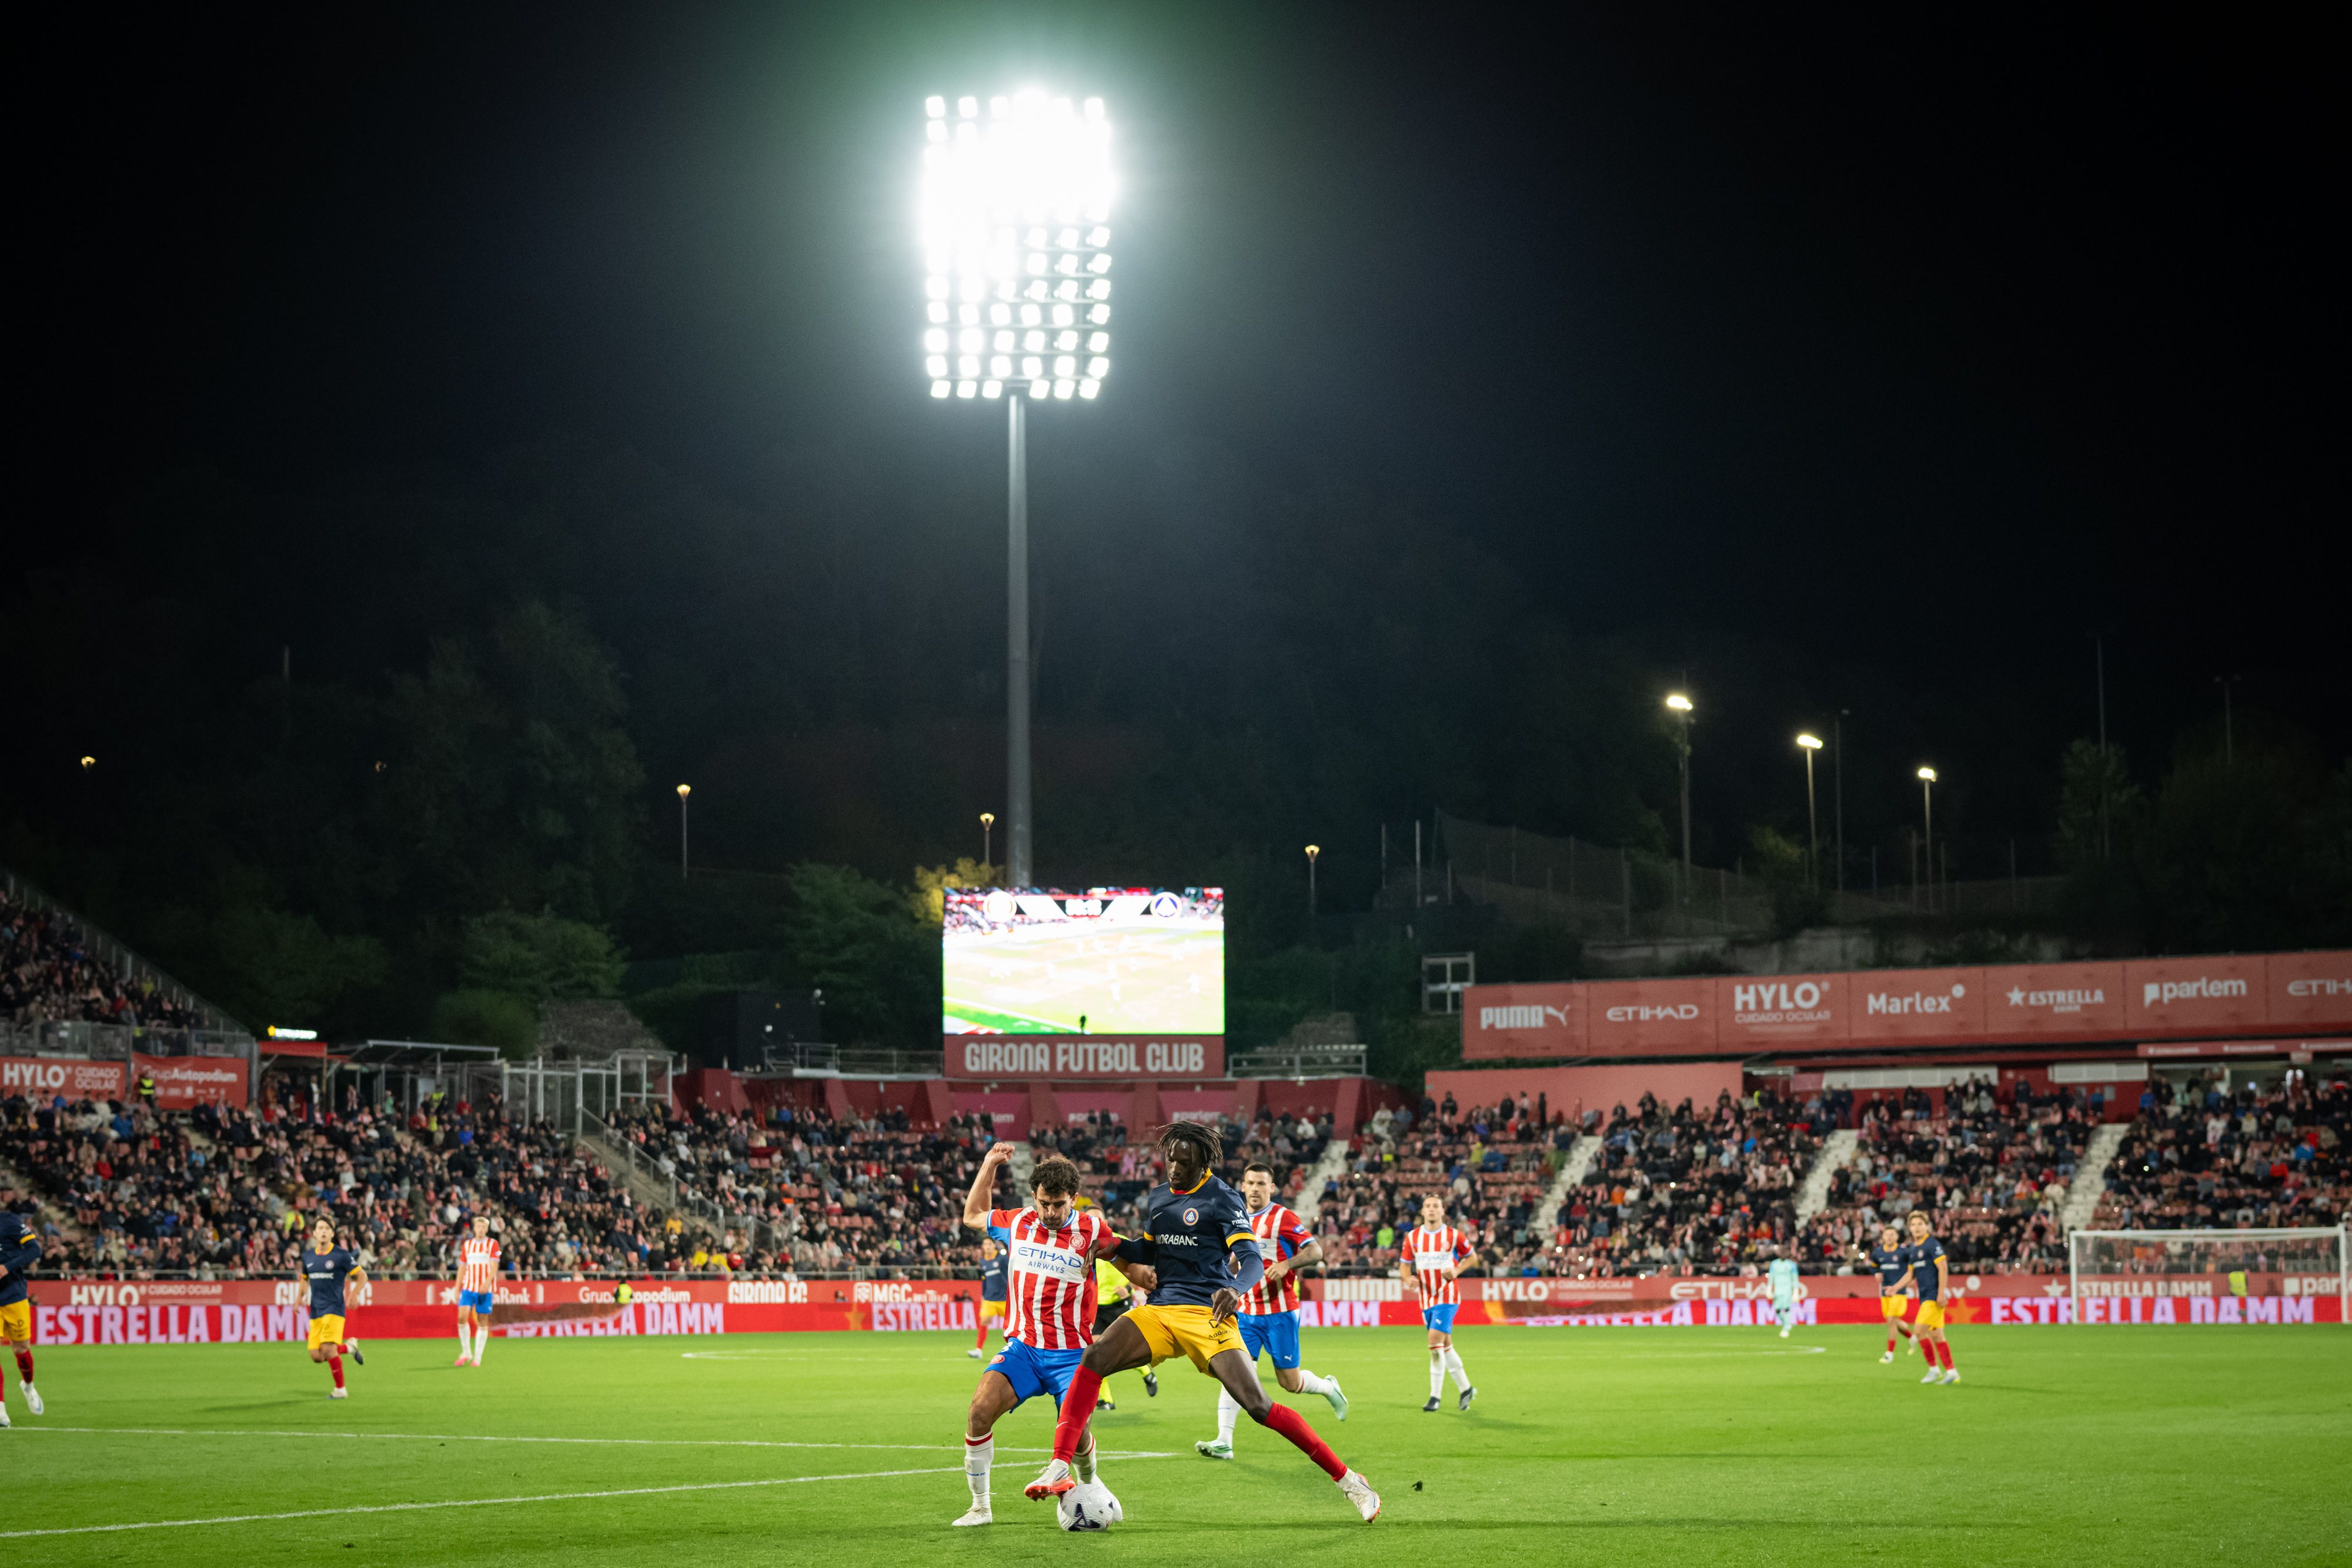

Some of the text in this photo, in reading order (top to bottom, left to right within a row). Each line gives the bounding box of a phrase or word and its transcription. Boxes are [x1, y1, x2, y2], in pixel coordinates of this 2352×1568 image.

[1735, 982, 1820, 1011] HYLO
[2029, 989, 2104, 1007] ESTRELLA
[2163, 978, 2247, 1004] parlem
[2287, 979, 2352, 996] ETIH
[1606, 1003, 1699, 1022] ETIHAD
[1867, 991, 1951, 1015] Marlex
[1481, 1005, 1543, 1030] PUMA
[965, 1044, 1204, 1072] GIRONA FUTBOL CLUB
[4, 1063, 66, 1088] HYLO
[1018, 1246, 1083, 1268] ETIHAD
[1028, 1261, 1065, 1273] AIRWAYS
[873, 1283, 913, 1303] MGC
[1481, 1281, 1549, 1302] HYLO
[1670, 1281, 1808, 1300] ETIHA
[2079, 1281, 2212, 1296] STRELLA DAMM
[644, 1303, 724, 1335] DAMM
[871, 1302, 978, 1332] ESTRELLA
[1299, 1301, 1381, 1326] AMM
[1991, 1296, 2314, 1325] ESTRELLA DAMM
[36, 1306, 211, 1345] ESTRELLA
